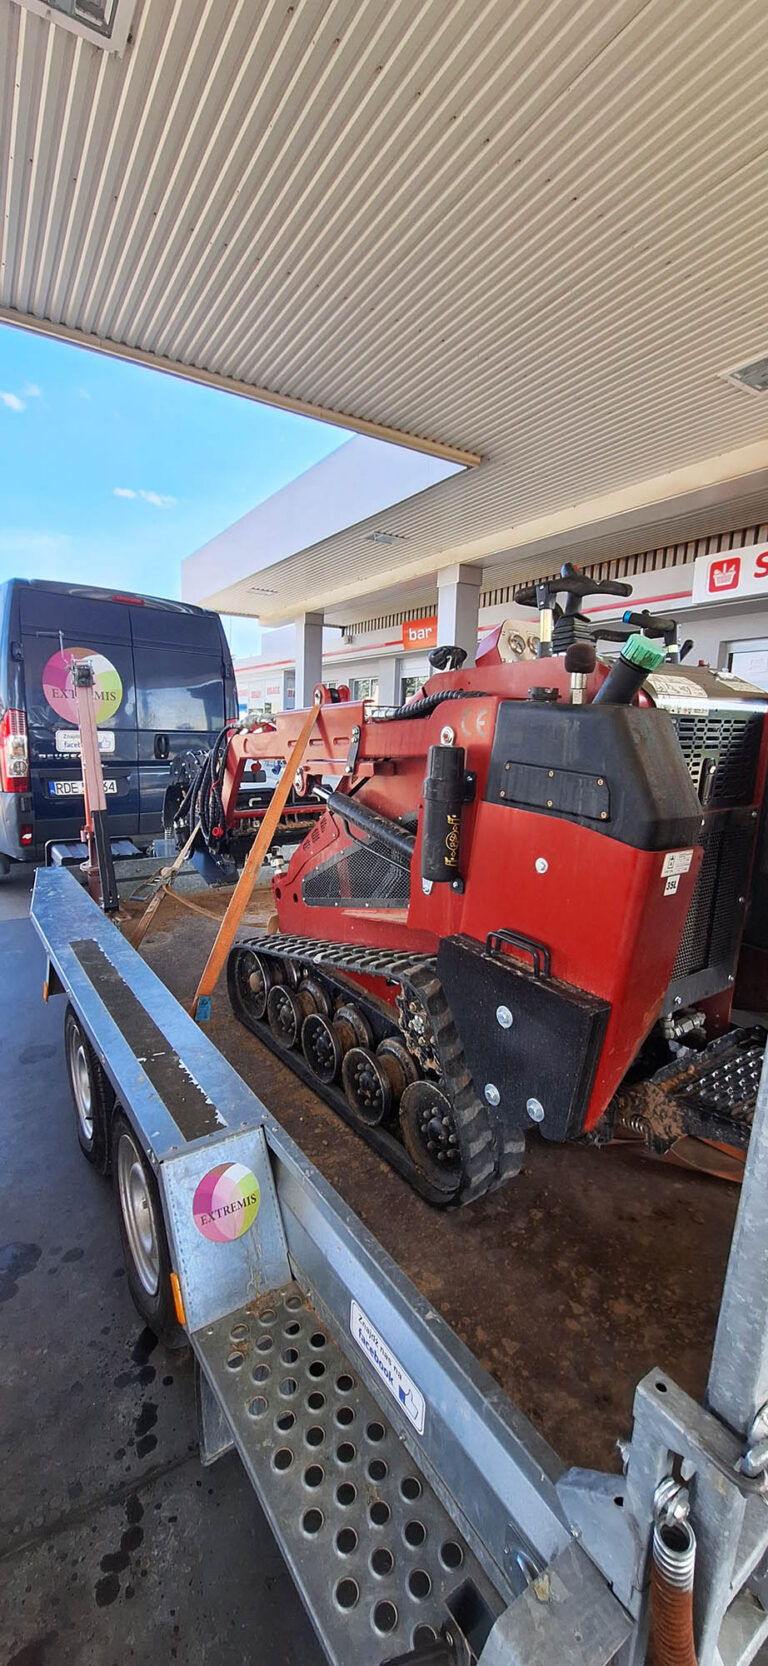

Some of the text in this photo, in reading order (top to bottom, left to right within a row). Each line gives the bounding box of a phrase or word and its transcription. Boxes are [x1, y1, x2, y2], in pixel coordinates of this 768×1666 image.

[409, 627, 432, 641] bar
[51, 688, 117, 701] EXTMIS
[461, 708, 488, 737] CE
[55, 782, 79, 795] RDE
[200, 1193, 257, 1226] EXTREMIS
[358, 1327, 395, 1387] facebook
[379, 1344, 392, 1366] nas
[393, 1364, 403, 1381] na
